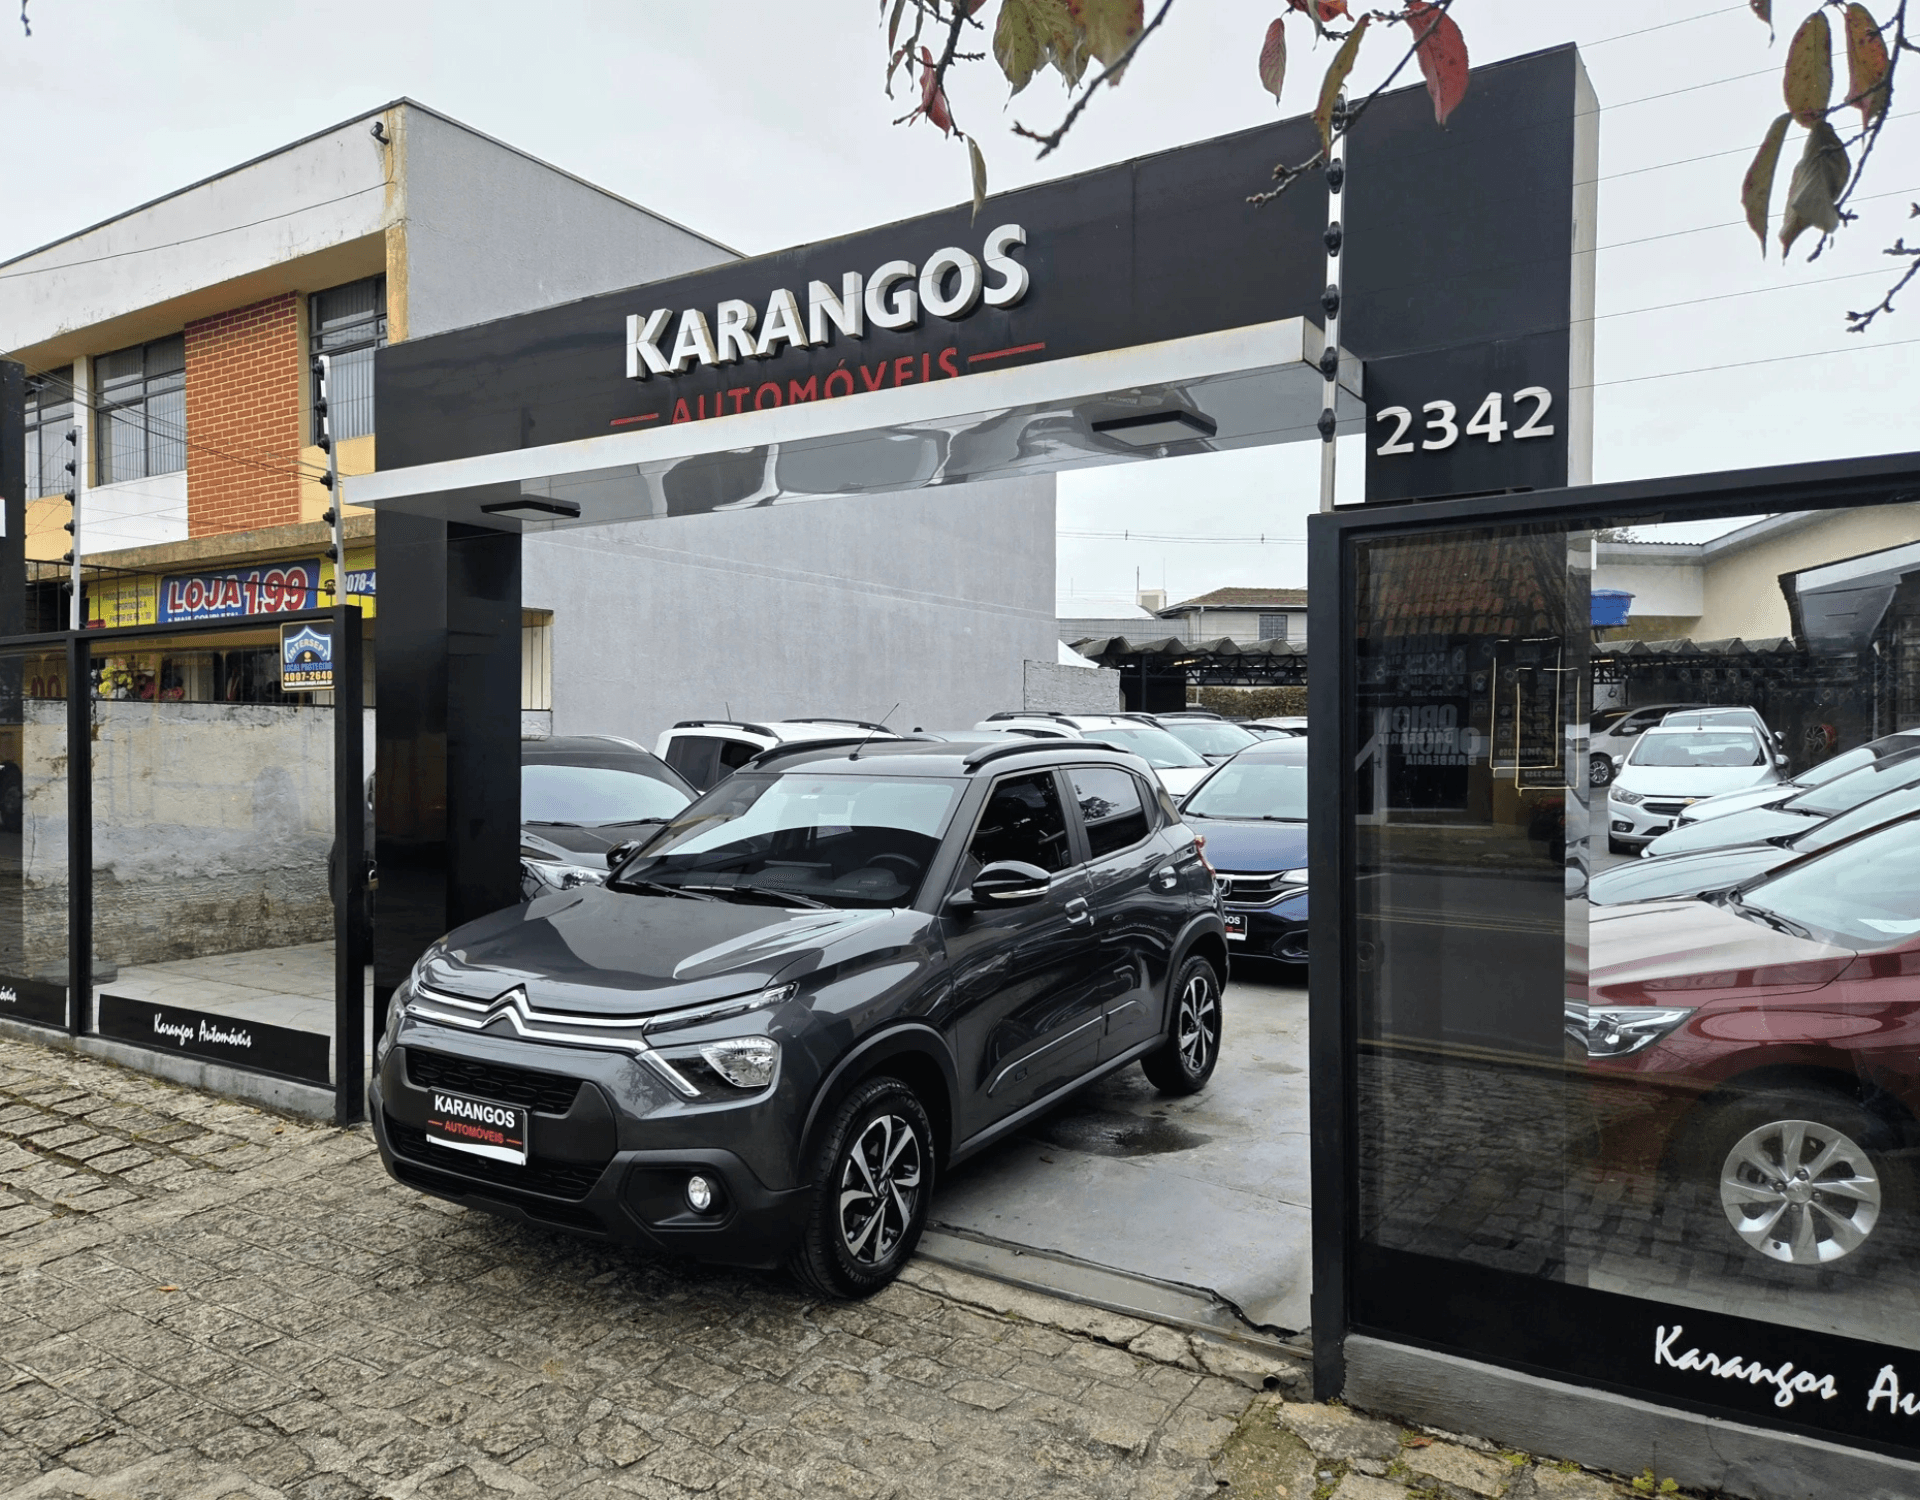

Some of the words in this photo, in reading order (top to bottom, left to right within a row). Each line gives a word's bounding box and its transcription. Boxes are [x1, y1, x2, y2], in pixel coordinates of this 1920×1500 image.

[626, 223, 1029, 381] KARANGOS
[671, 347, 959, 425] AUTOMÓVEIS
[1376, 386, 1555, 456] 2342
[167, 575, 242, 614] LOJA
[343, 572, 377, 592] 078-4
[287, 638, 328, 660] INTERSEPT
[154, 1012, 194, 1046] Karangos
[198, 1019, 253, 1048] Automóveis
[434, 1094, 516, 1129] KARANGOS
[444, 1120, 505, 1144] AUTOMÓVEIS
[1654, 1324, 1838, 1408] Karangos
